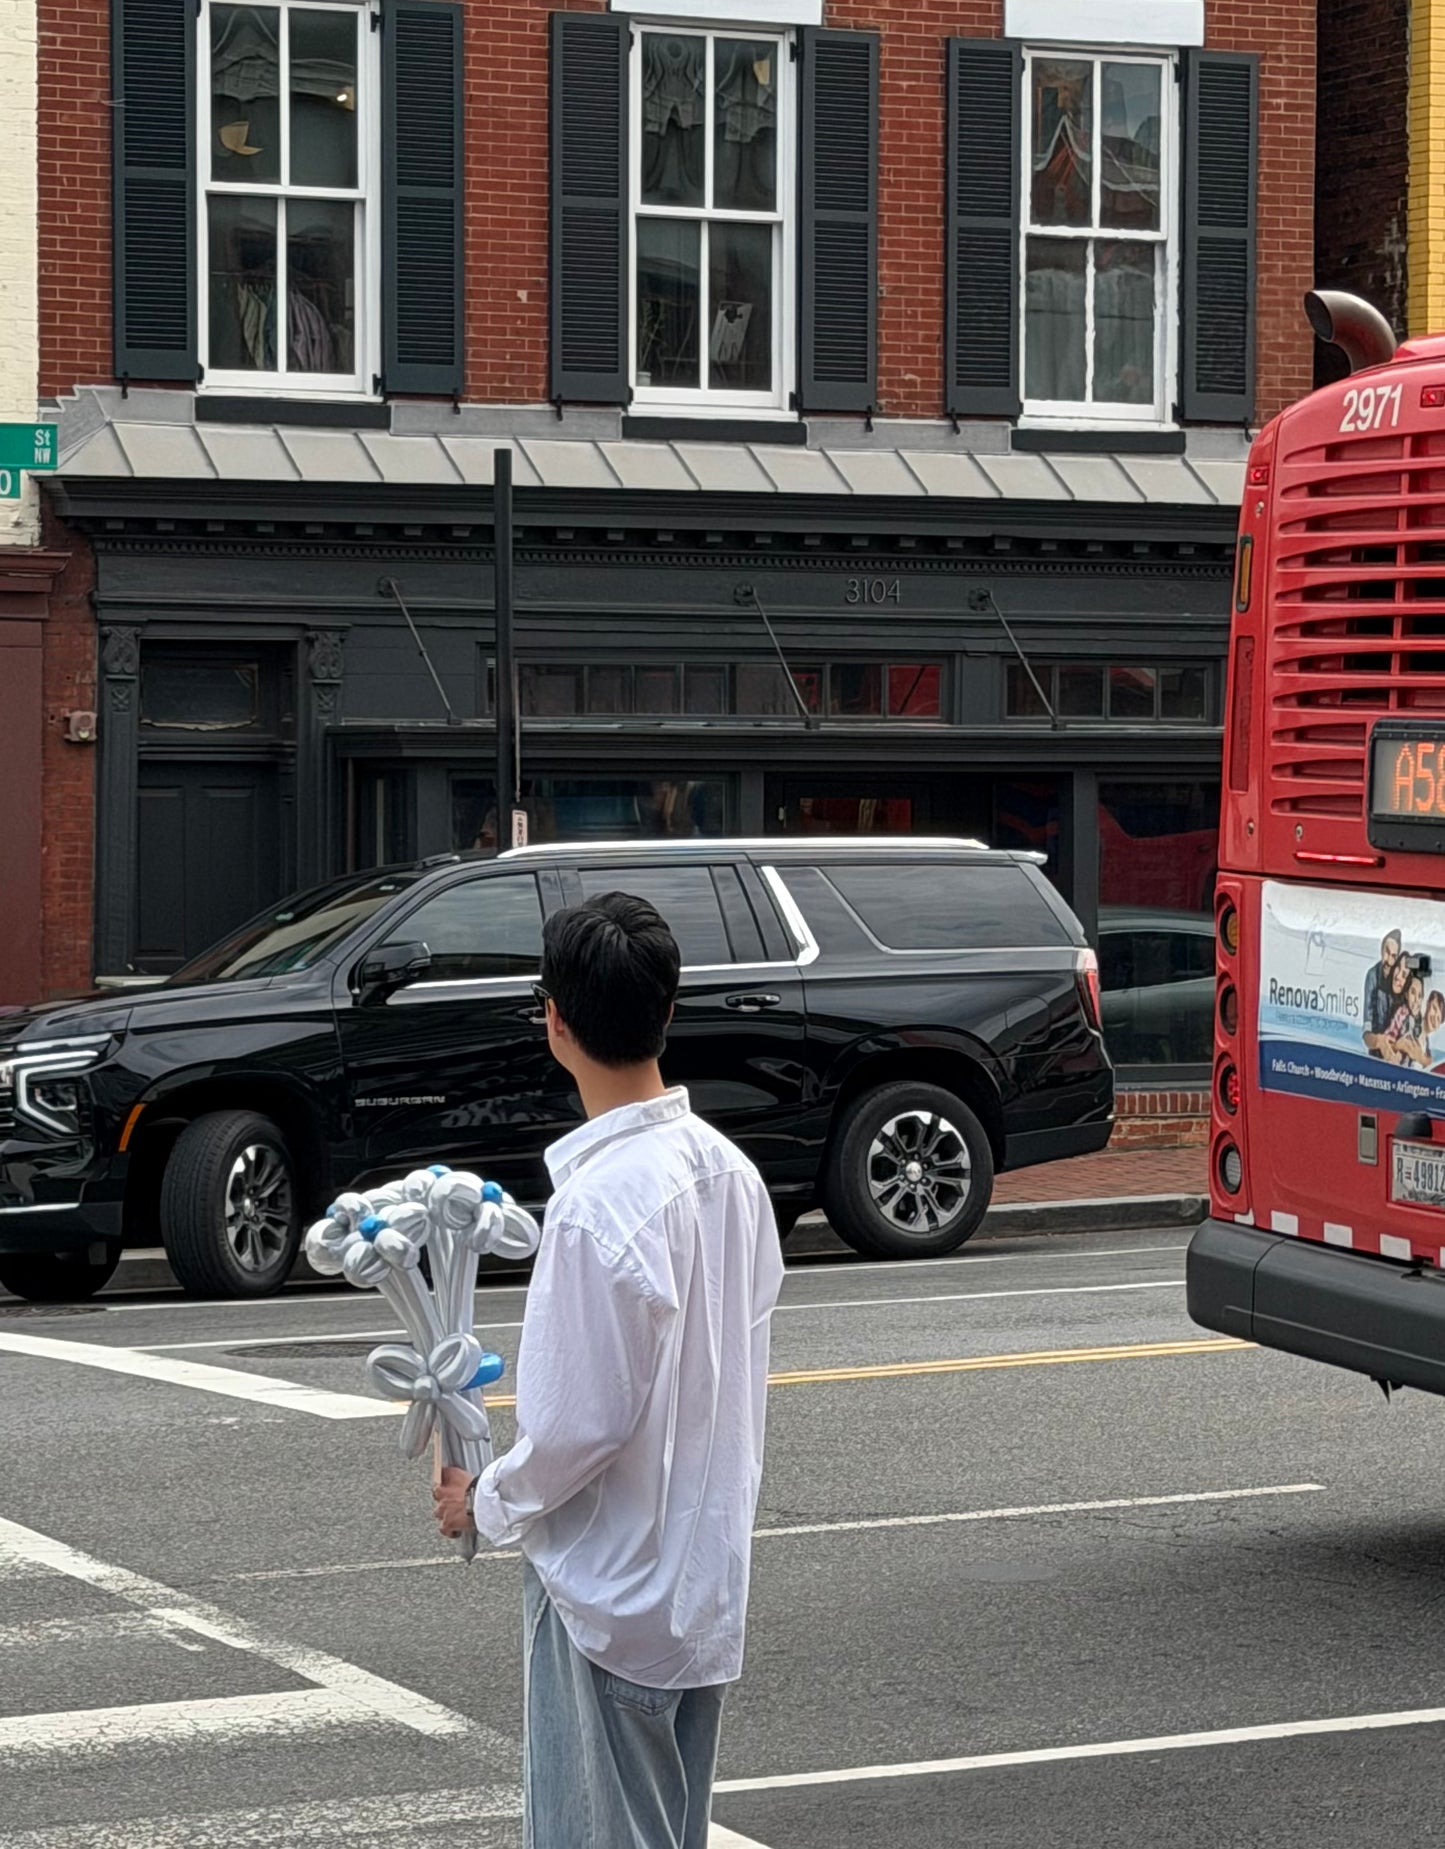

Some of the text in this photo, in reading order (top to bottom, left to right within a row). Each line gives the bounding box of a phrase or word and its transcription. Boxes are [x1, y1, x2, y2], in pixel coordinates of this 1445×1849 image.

[1339, 383, 1403, 432] 2971
[34, 429, 50, 446] St
[34, 447, 51, 464] NW
[846, 578, 901, 603] 3104
[1269, 978, 1359, 1018] RenovaSmiles
[1272, 1058, 1286, 1073] Falls
[1287, 1061, 1310, 1076] Church
[1314, 1066, 1354, 1087] Woodbridge
[1359, 1074, 1391, 1092] Manassas
[1396, 1080, 1430, 1099] Arlington
[355, 1096, 446, 1107] SUBURBAN
